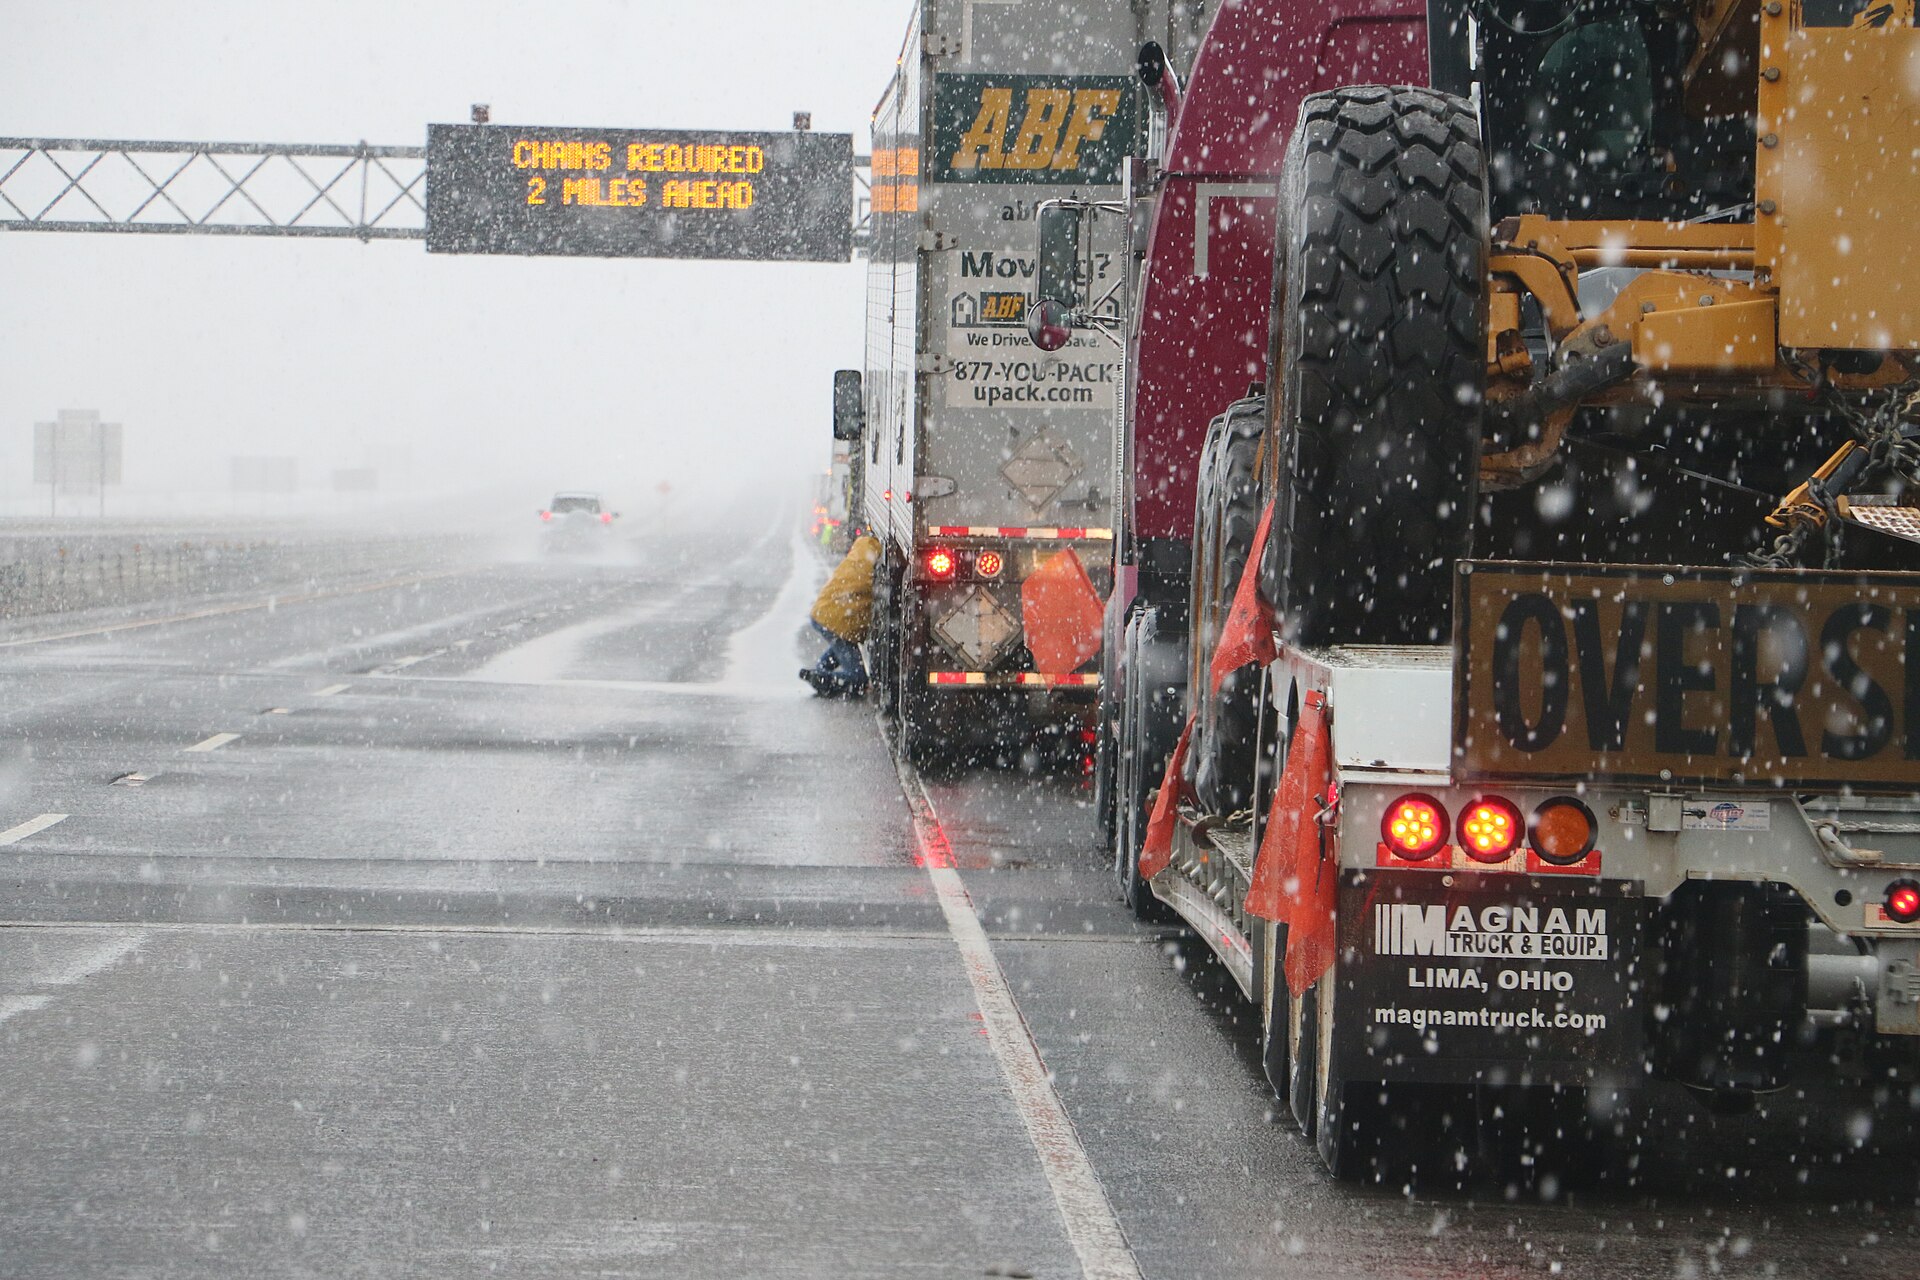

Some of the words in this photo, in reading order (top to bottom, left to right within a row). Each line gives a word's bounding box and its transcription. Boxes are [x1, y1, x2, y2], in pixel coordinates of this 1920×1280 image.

[951, 88, 1121, 169] ABF
[513, 140, 612, 171] CHAINS
[627, 143, 764, 174] REQUIRED
[526, 176, 546, 205] 2
[562, 178, 647, 207] MILES
[662, 180, 753, 209] AHEAD
[961, 252, 1111, 286] Movg?
[982, 296, 1024, 318] ABF
[967, 333, 988, 346] We
[974, 385, 1093, 406] upack.com
[1402, 904, 1607, 956] MAGNAM
[1450, 933, 1514, 954] TRUCK
[1521, 935, 1533, 954] &
[1541, 935, 1603, 956] EQUIP.
[1408, 968, 1489, 993] LIMA,
[1497, 969, 1574, 991] OHIO
[1375, 1007, 1607, 1030] magnamtruck.com
